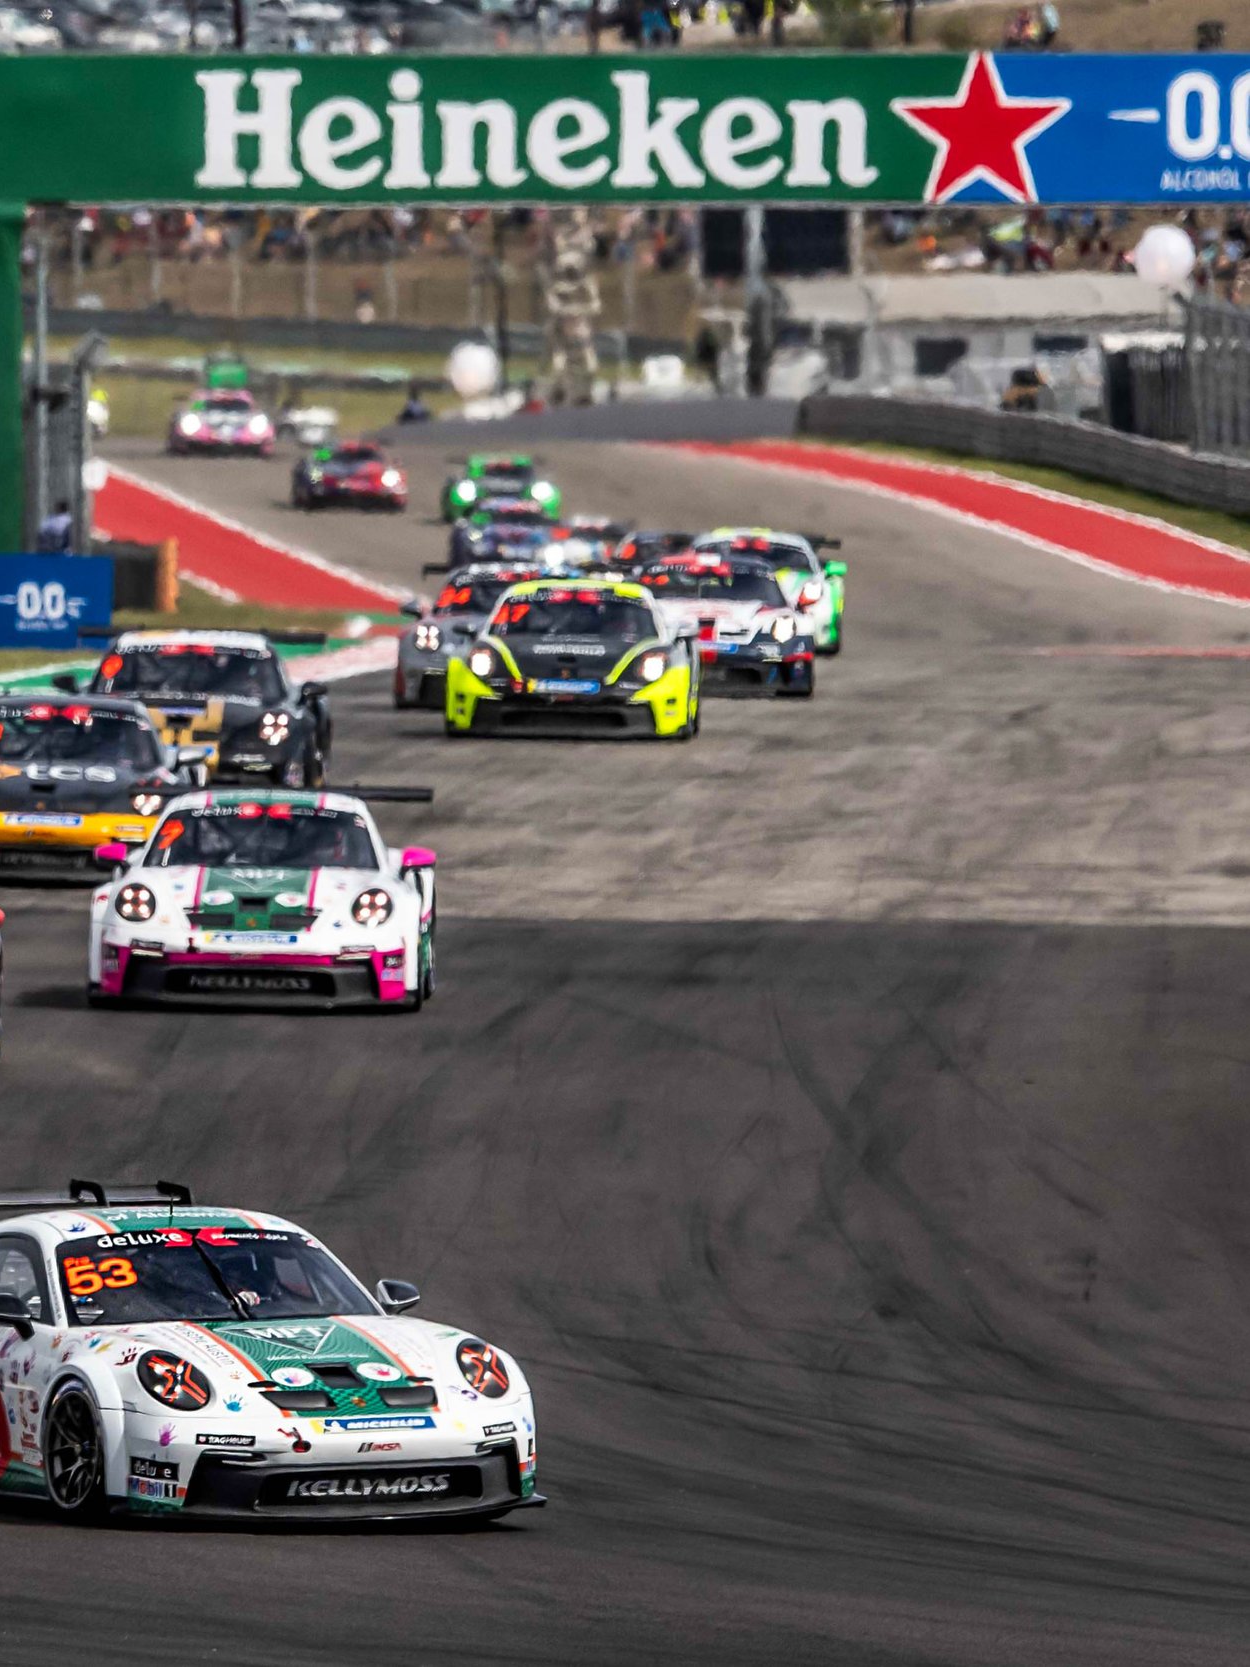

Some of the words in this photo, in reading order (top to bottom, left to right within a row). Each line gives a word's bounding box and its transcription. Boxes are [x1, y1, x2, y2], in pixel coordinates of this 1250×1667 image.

[196, 69, 879, 190] Heineken
[96, 1232, 184, 1249] deluxe
[67, 1257, 138, 1296] 53
[347, 1418, 426, 1430] MICHELIN
[287, 1473, 450, 1497] KELLYMOSS
